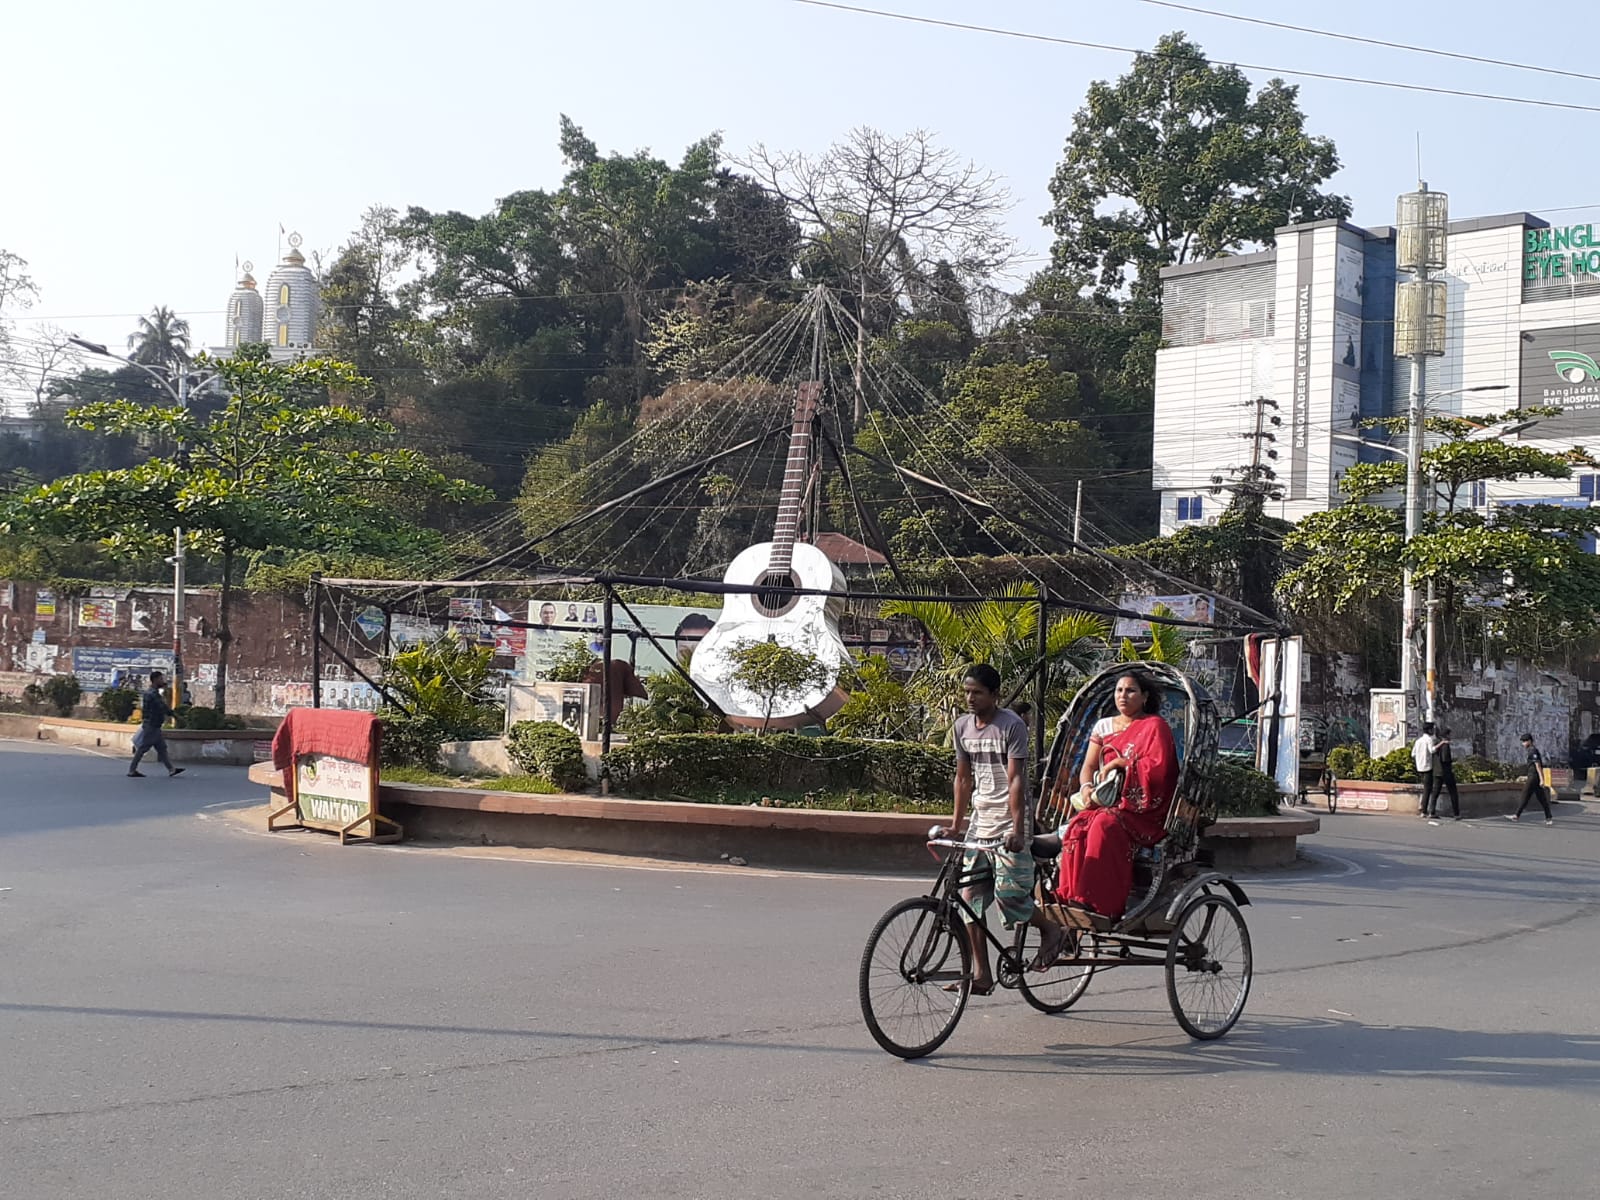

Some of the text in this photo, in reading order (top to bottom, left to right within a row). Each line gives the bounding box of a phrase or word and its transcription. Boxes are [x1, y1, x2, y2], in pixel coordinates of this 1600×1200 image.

[1525, 224, 1600, 253] BANGL
[1525, 254, 1565, 280] EYE
[1572, 250, 1600, 274] HO
[1296, 284, 1310, 448] BANGLADESH EYE HOSPITAL
[1543, 397, 1561, 406] EYE
[311, 799, 358, 823] WALTON
